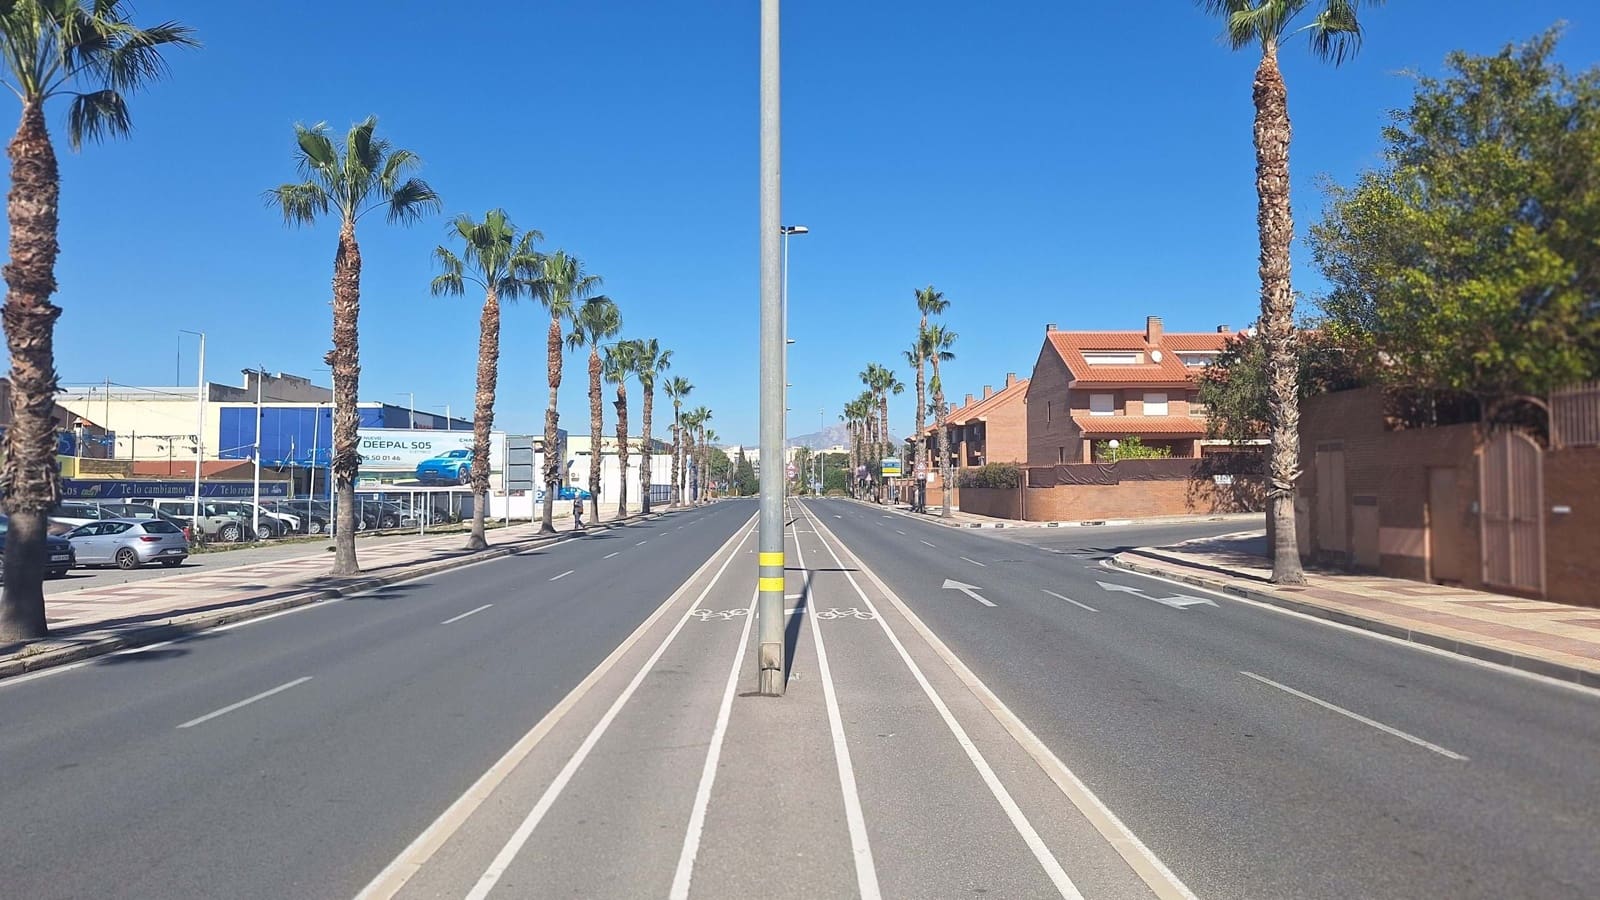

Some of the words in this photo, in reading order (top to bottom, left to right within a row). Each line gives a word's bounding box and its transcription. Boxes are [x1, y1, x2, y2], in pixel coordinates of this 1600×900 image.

[363, 440, 409, 449] DEEPAL
[411, 441, 432, 450] S05
[121, 483, 132, 495] Te
[133, 483, 142, 495] lo
[144, 484, 186, 495] cambiamos
[221, 485, 230, 495] Te
[230, 485, 238, 495] lo
